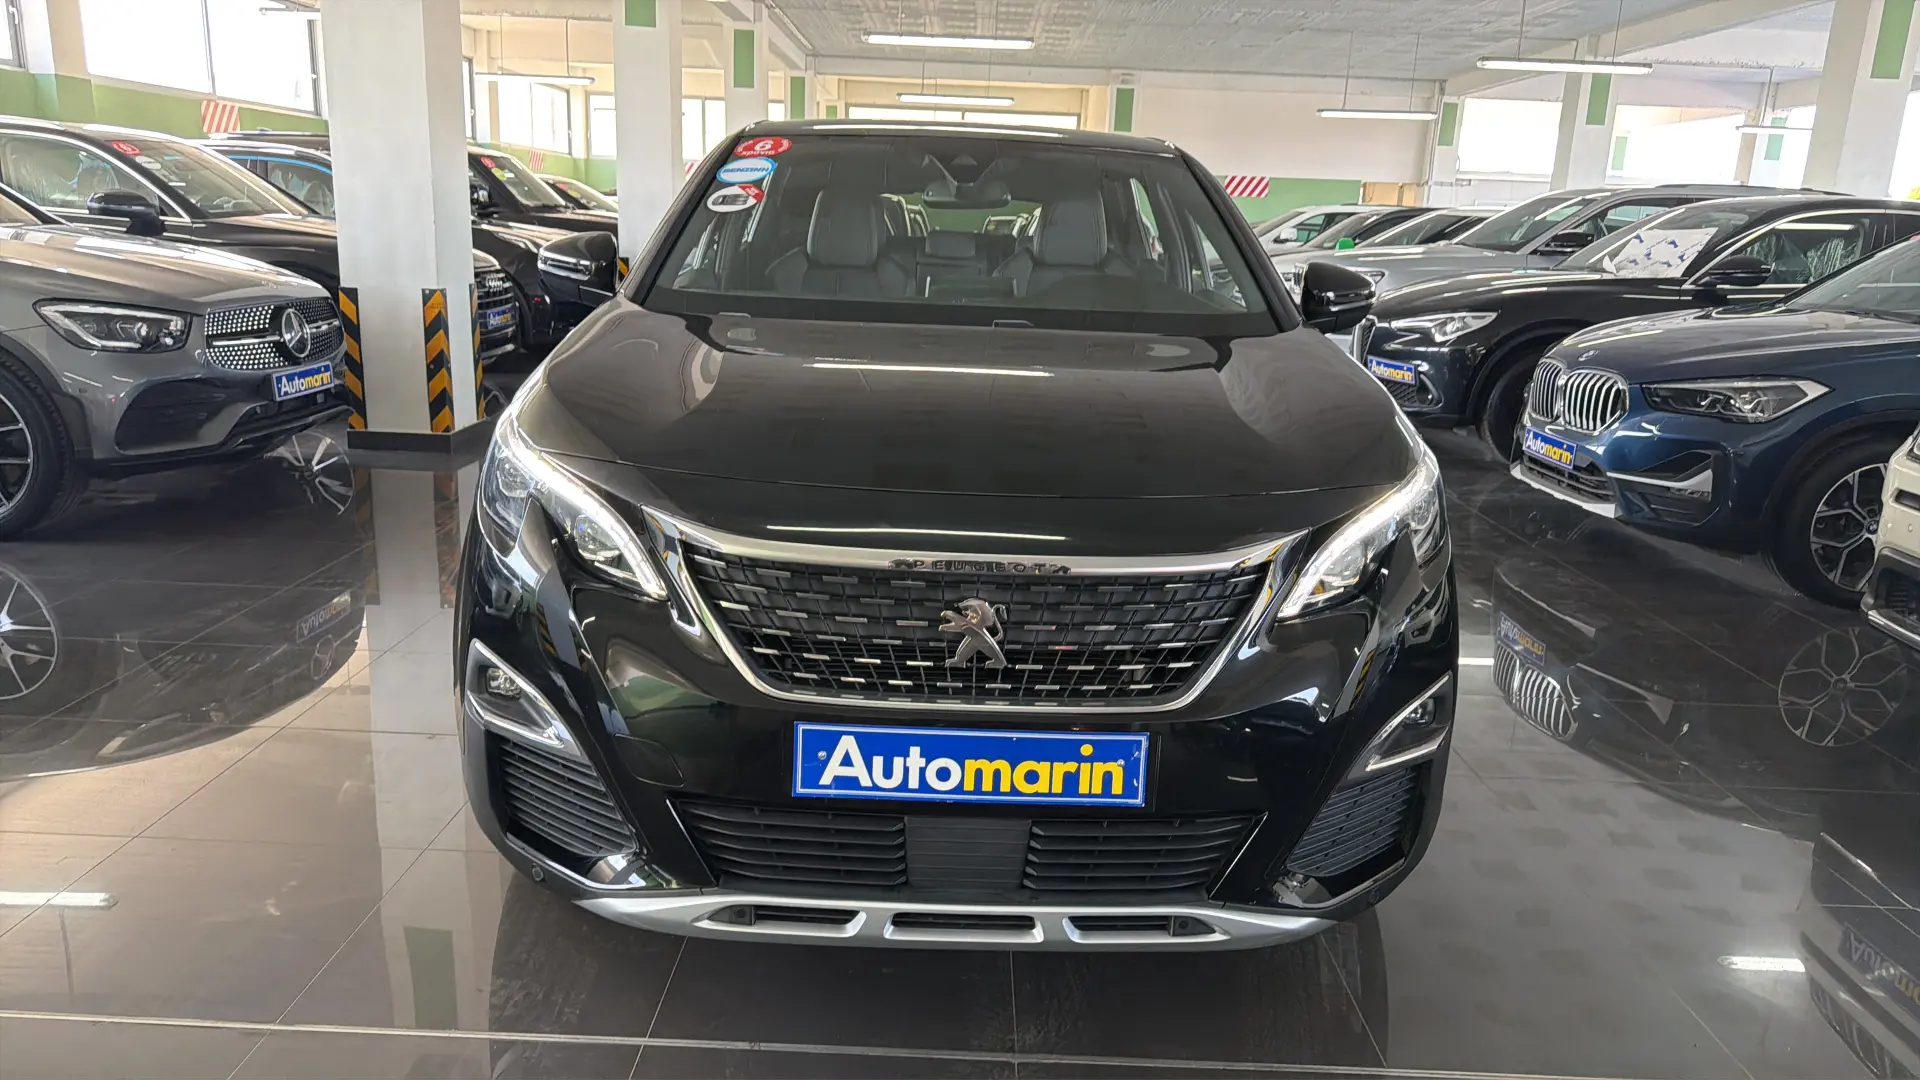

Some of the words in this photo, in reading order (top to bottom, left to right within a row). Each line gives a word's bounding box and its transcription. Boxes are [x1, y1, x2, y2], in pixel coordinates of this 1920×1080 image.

[754, 139, 775, 151] 6
[489, 308, 512, 326] Autom
[280, 366, 332, 396] Automarin
[1370, 359, 1414, 381] Automarin
[1525, 430, 1572, 465] Automarin
[913, 559, 1046, 574] PEUGEOT
[818, 734, 1125, 796] Automarin
